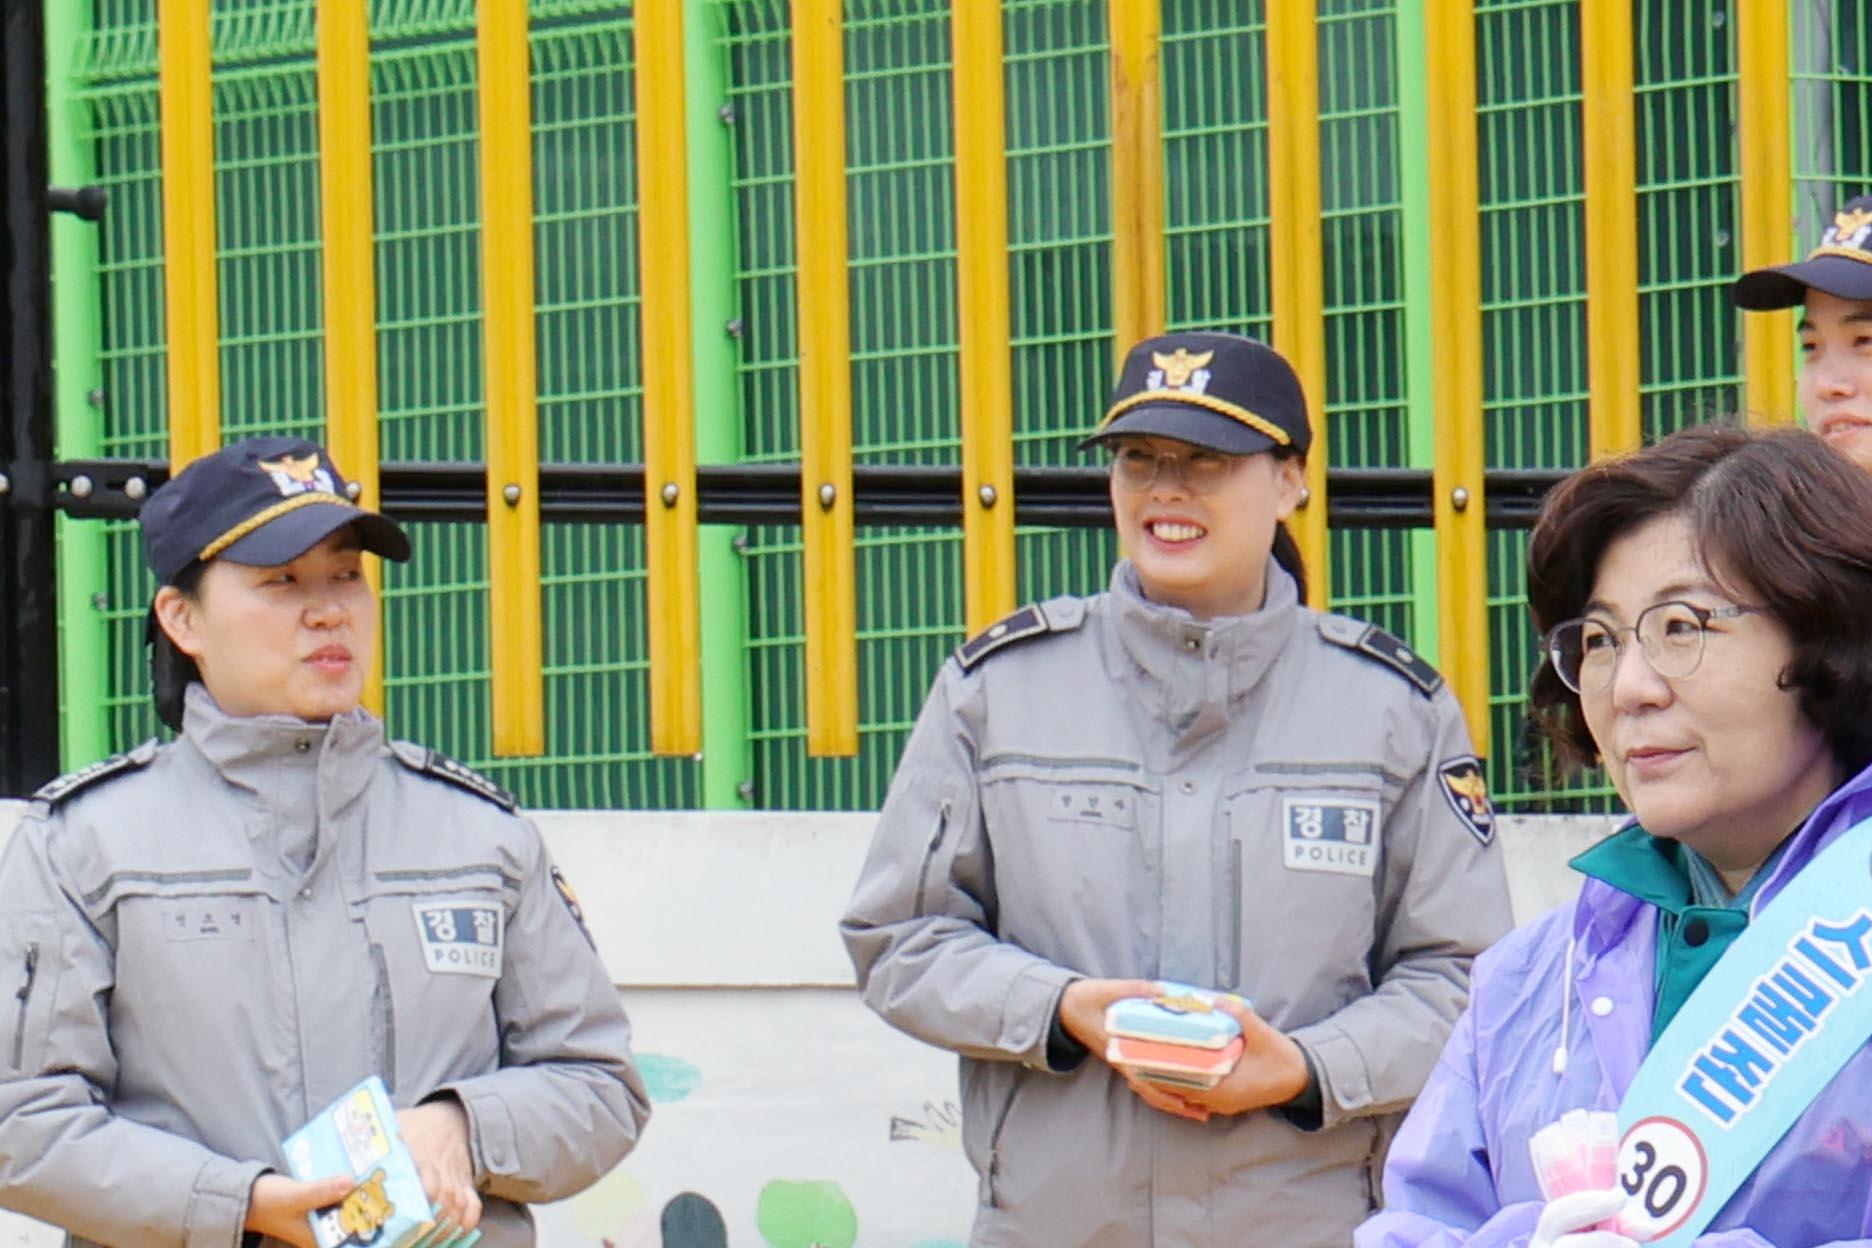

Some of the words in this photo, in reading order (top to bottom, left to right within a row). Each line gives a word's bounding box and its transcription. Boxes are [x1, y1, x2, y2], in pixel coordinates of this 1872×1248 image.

[1294, 806, 1370, 843] 경찰
[1293, 846, 1367, 866] POLICE
[426, 910, 497, 945] 경찰
[434, 948, 496, 967] POLICE
[1620, 1140, 1688, 1220] 30
